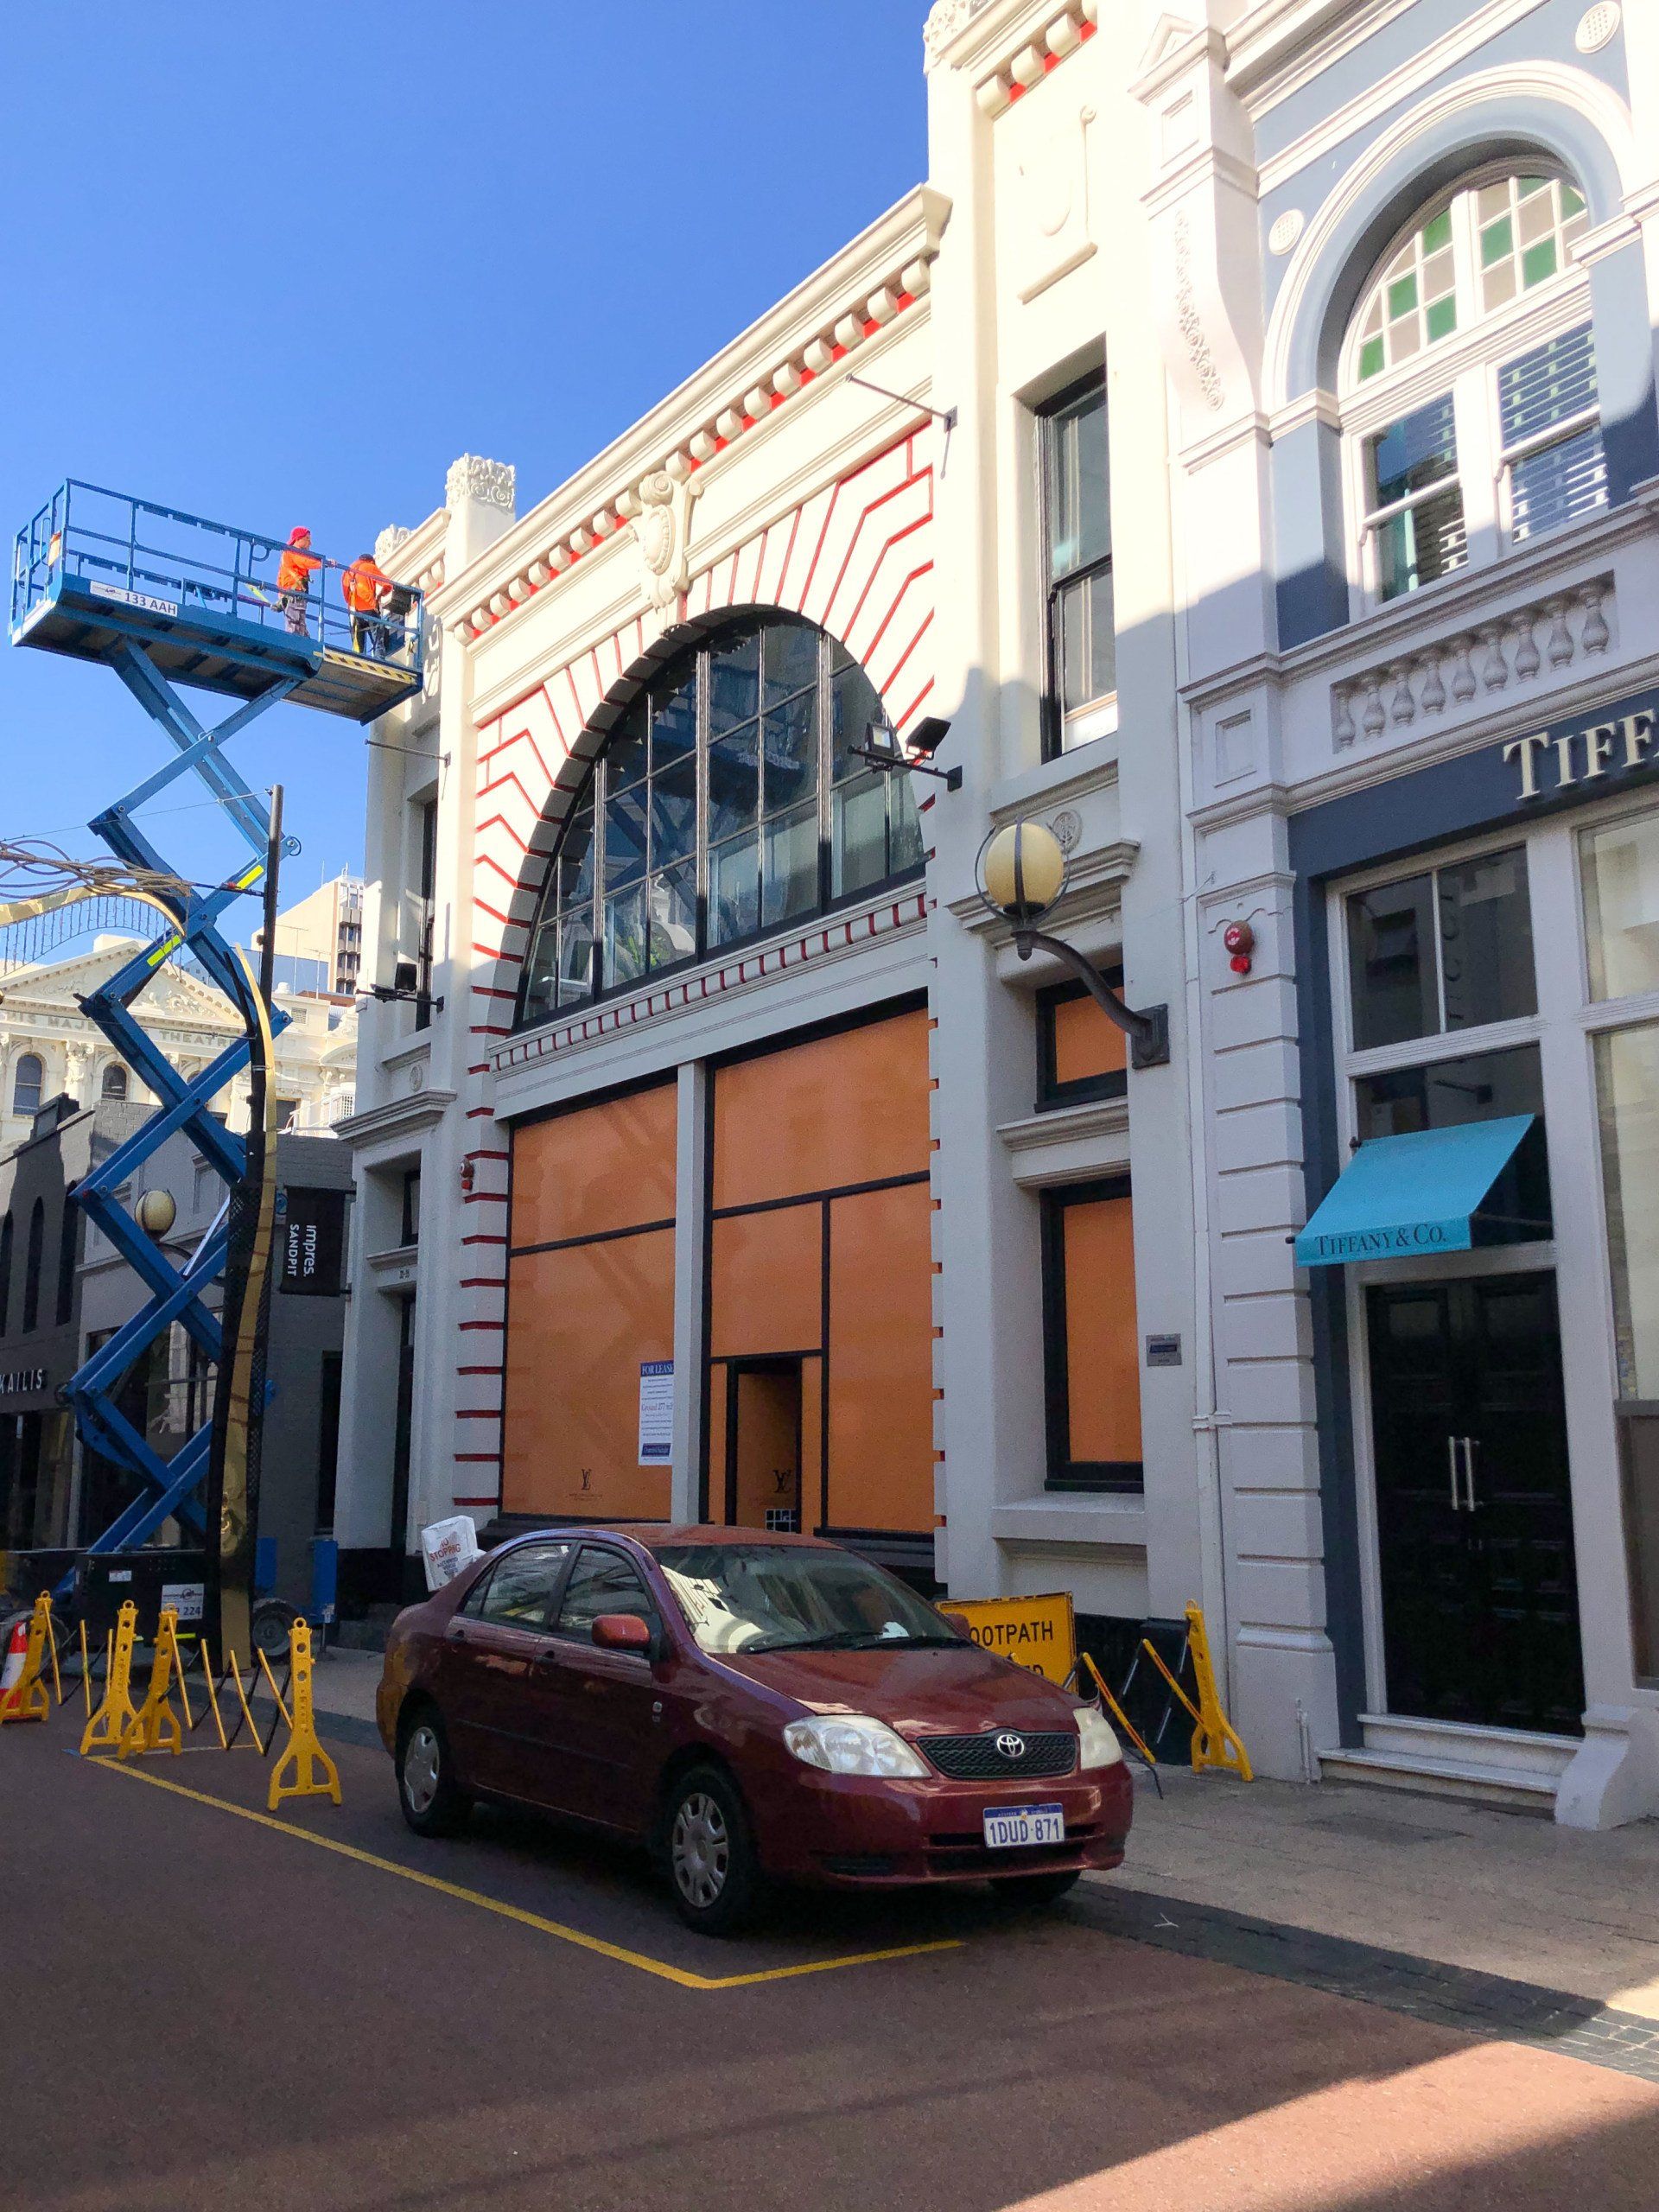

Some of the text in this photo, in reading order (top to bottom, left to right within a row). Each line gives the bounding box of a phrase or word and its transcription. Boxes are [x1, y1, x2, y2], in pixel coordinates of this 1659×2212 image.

[124, 592, 176, 615] 133 AAH
[1503, 709, 1659, 800] TIFF
[1395, 1227, 1411, 1248] &
[287, 1224, 300, 1277] SANDPIT
[0, 1369, 43, 1394] KAILIS
[642, 1363, 673, 1376] FOR LEASE
[182, 1605, 201, 1616] 224
[969, 1620, 1053, 1647] OOTPATH
[989, 1818, 1060, 1845] 1DUD 871
